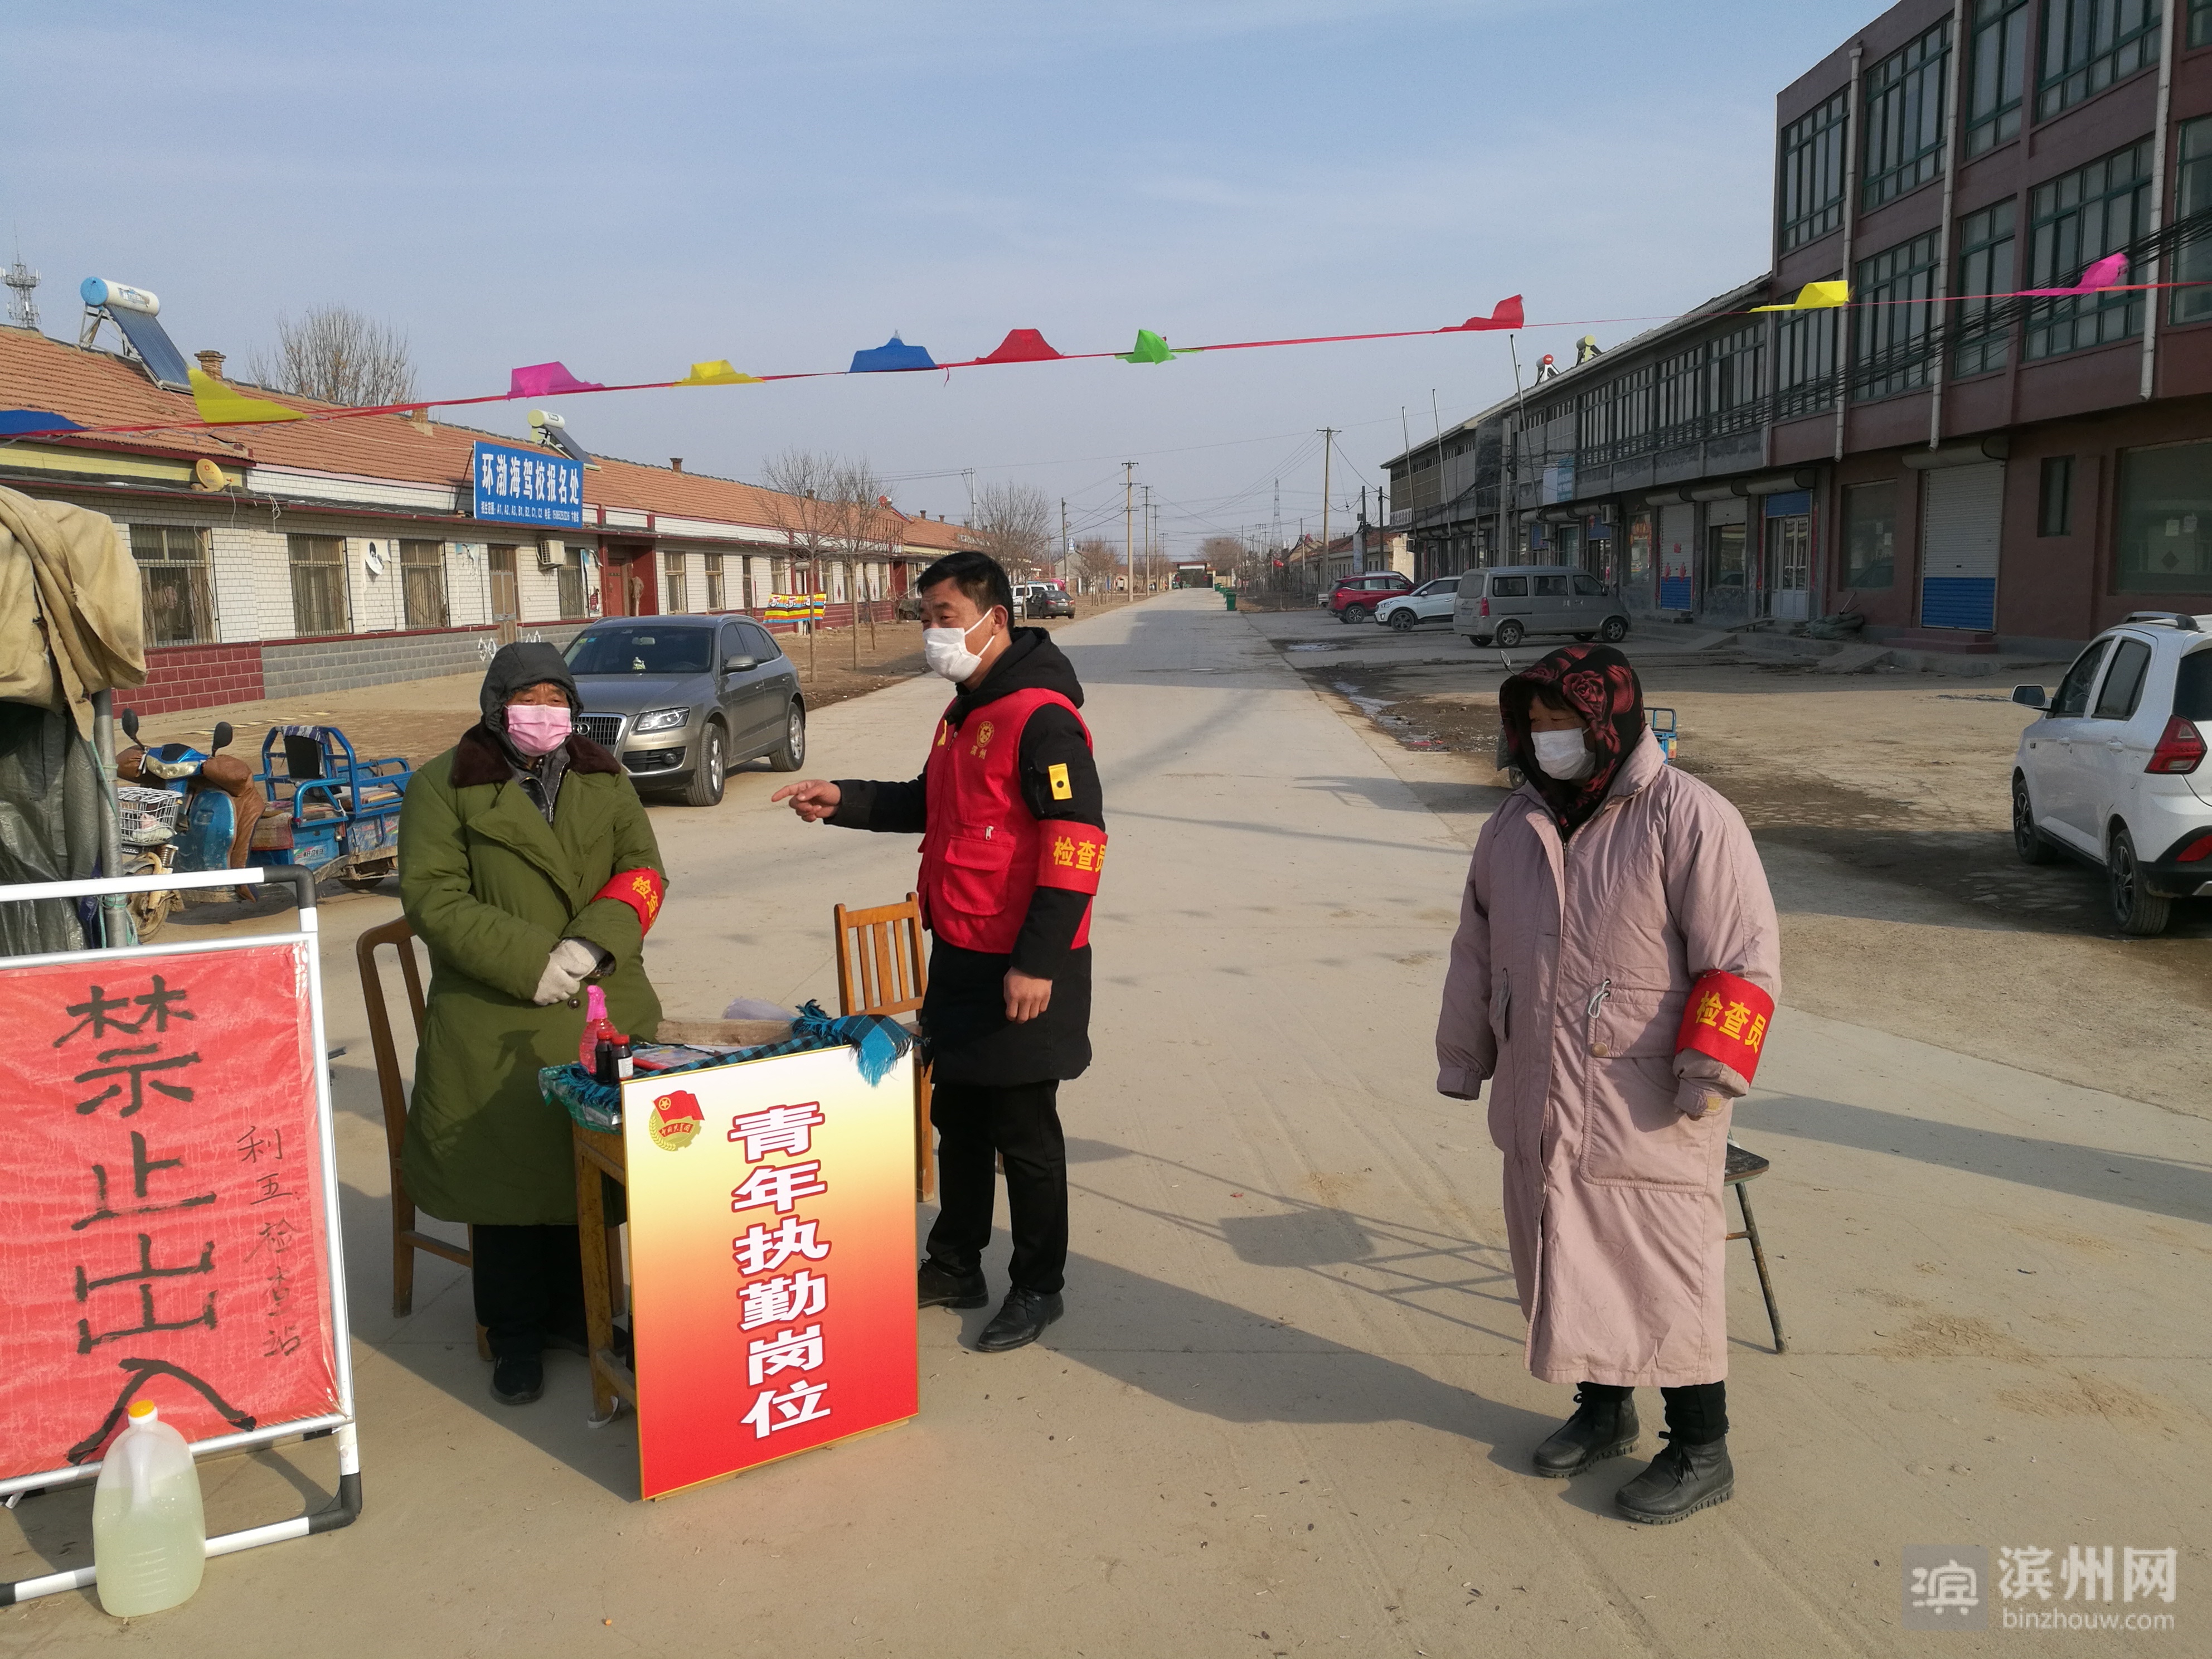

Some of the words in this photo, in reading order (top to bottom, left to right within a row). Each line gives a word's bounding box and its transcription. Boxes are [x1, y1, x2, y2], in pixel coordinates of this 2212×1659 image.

[482, 453, 579, 505] 环渤海驾校报名处
[632, 876, 658, 928] 检查
[1695, 991, 1766, 1054] 检查员
[53, 974, 257, 1464] 禁止出入
[729, 1102, 831, 1440] 青年执勤岗位
